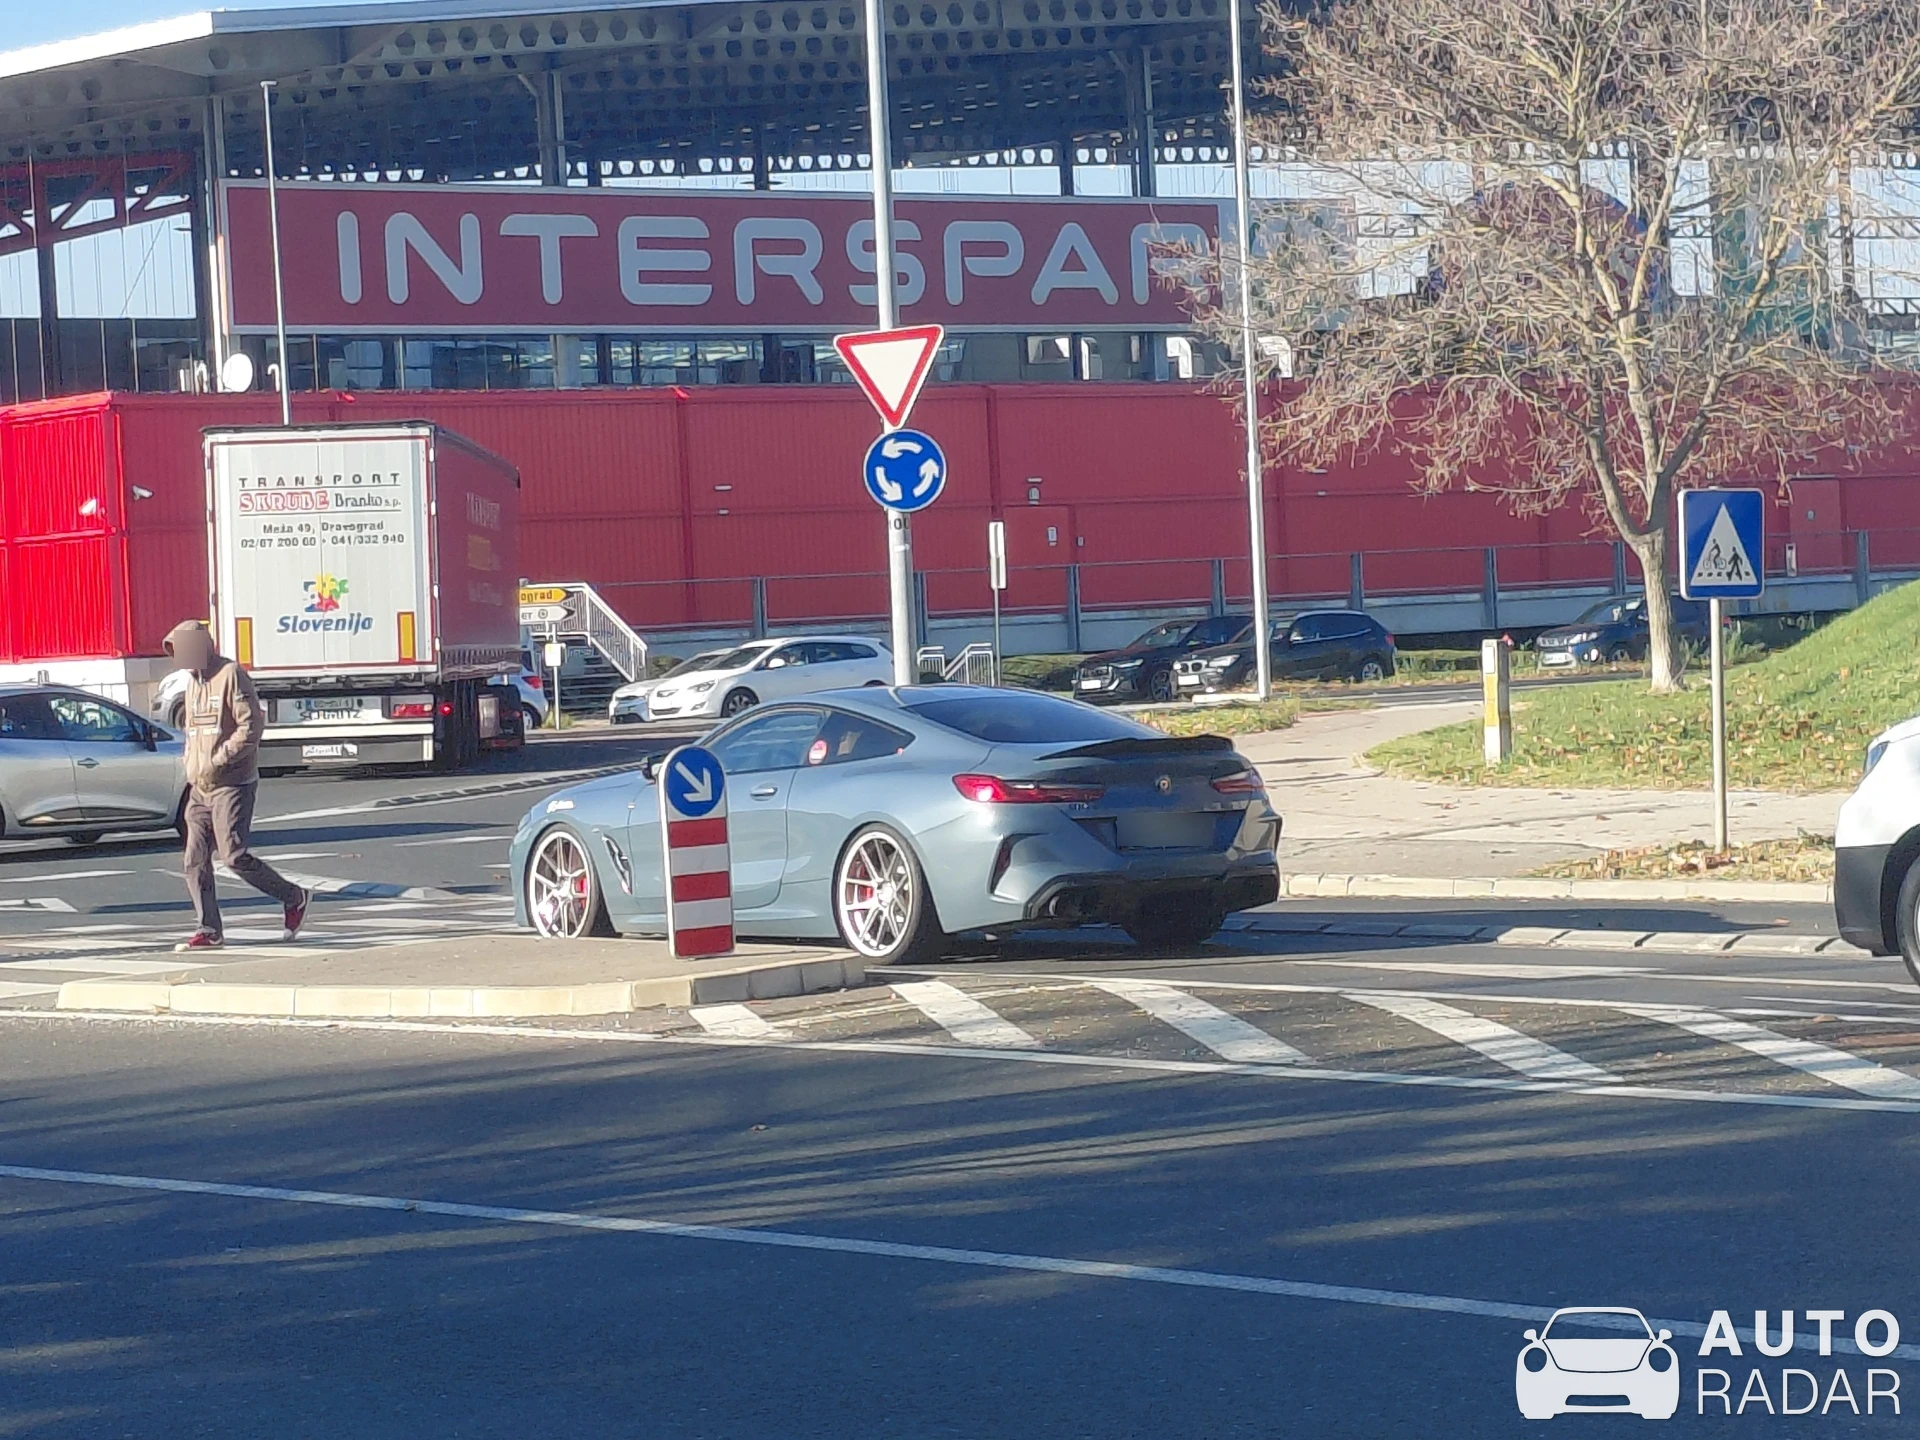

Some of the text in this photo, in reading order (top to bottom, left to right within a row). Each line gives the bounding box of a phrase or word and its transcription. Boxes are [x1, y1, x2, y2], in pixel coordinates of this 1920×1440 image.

[337, 211, 1210, 306] INTERSPAR
[238, 473, 400, 488] TRANSPORT
[334, 492, 383, 508] Branko
[520, 589, 553, 602] ograd
[276, 612, 374, 636] Slovenija
